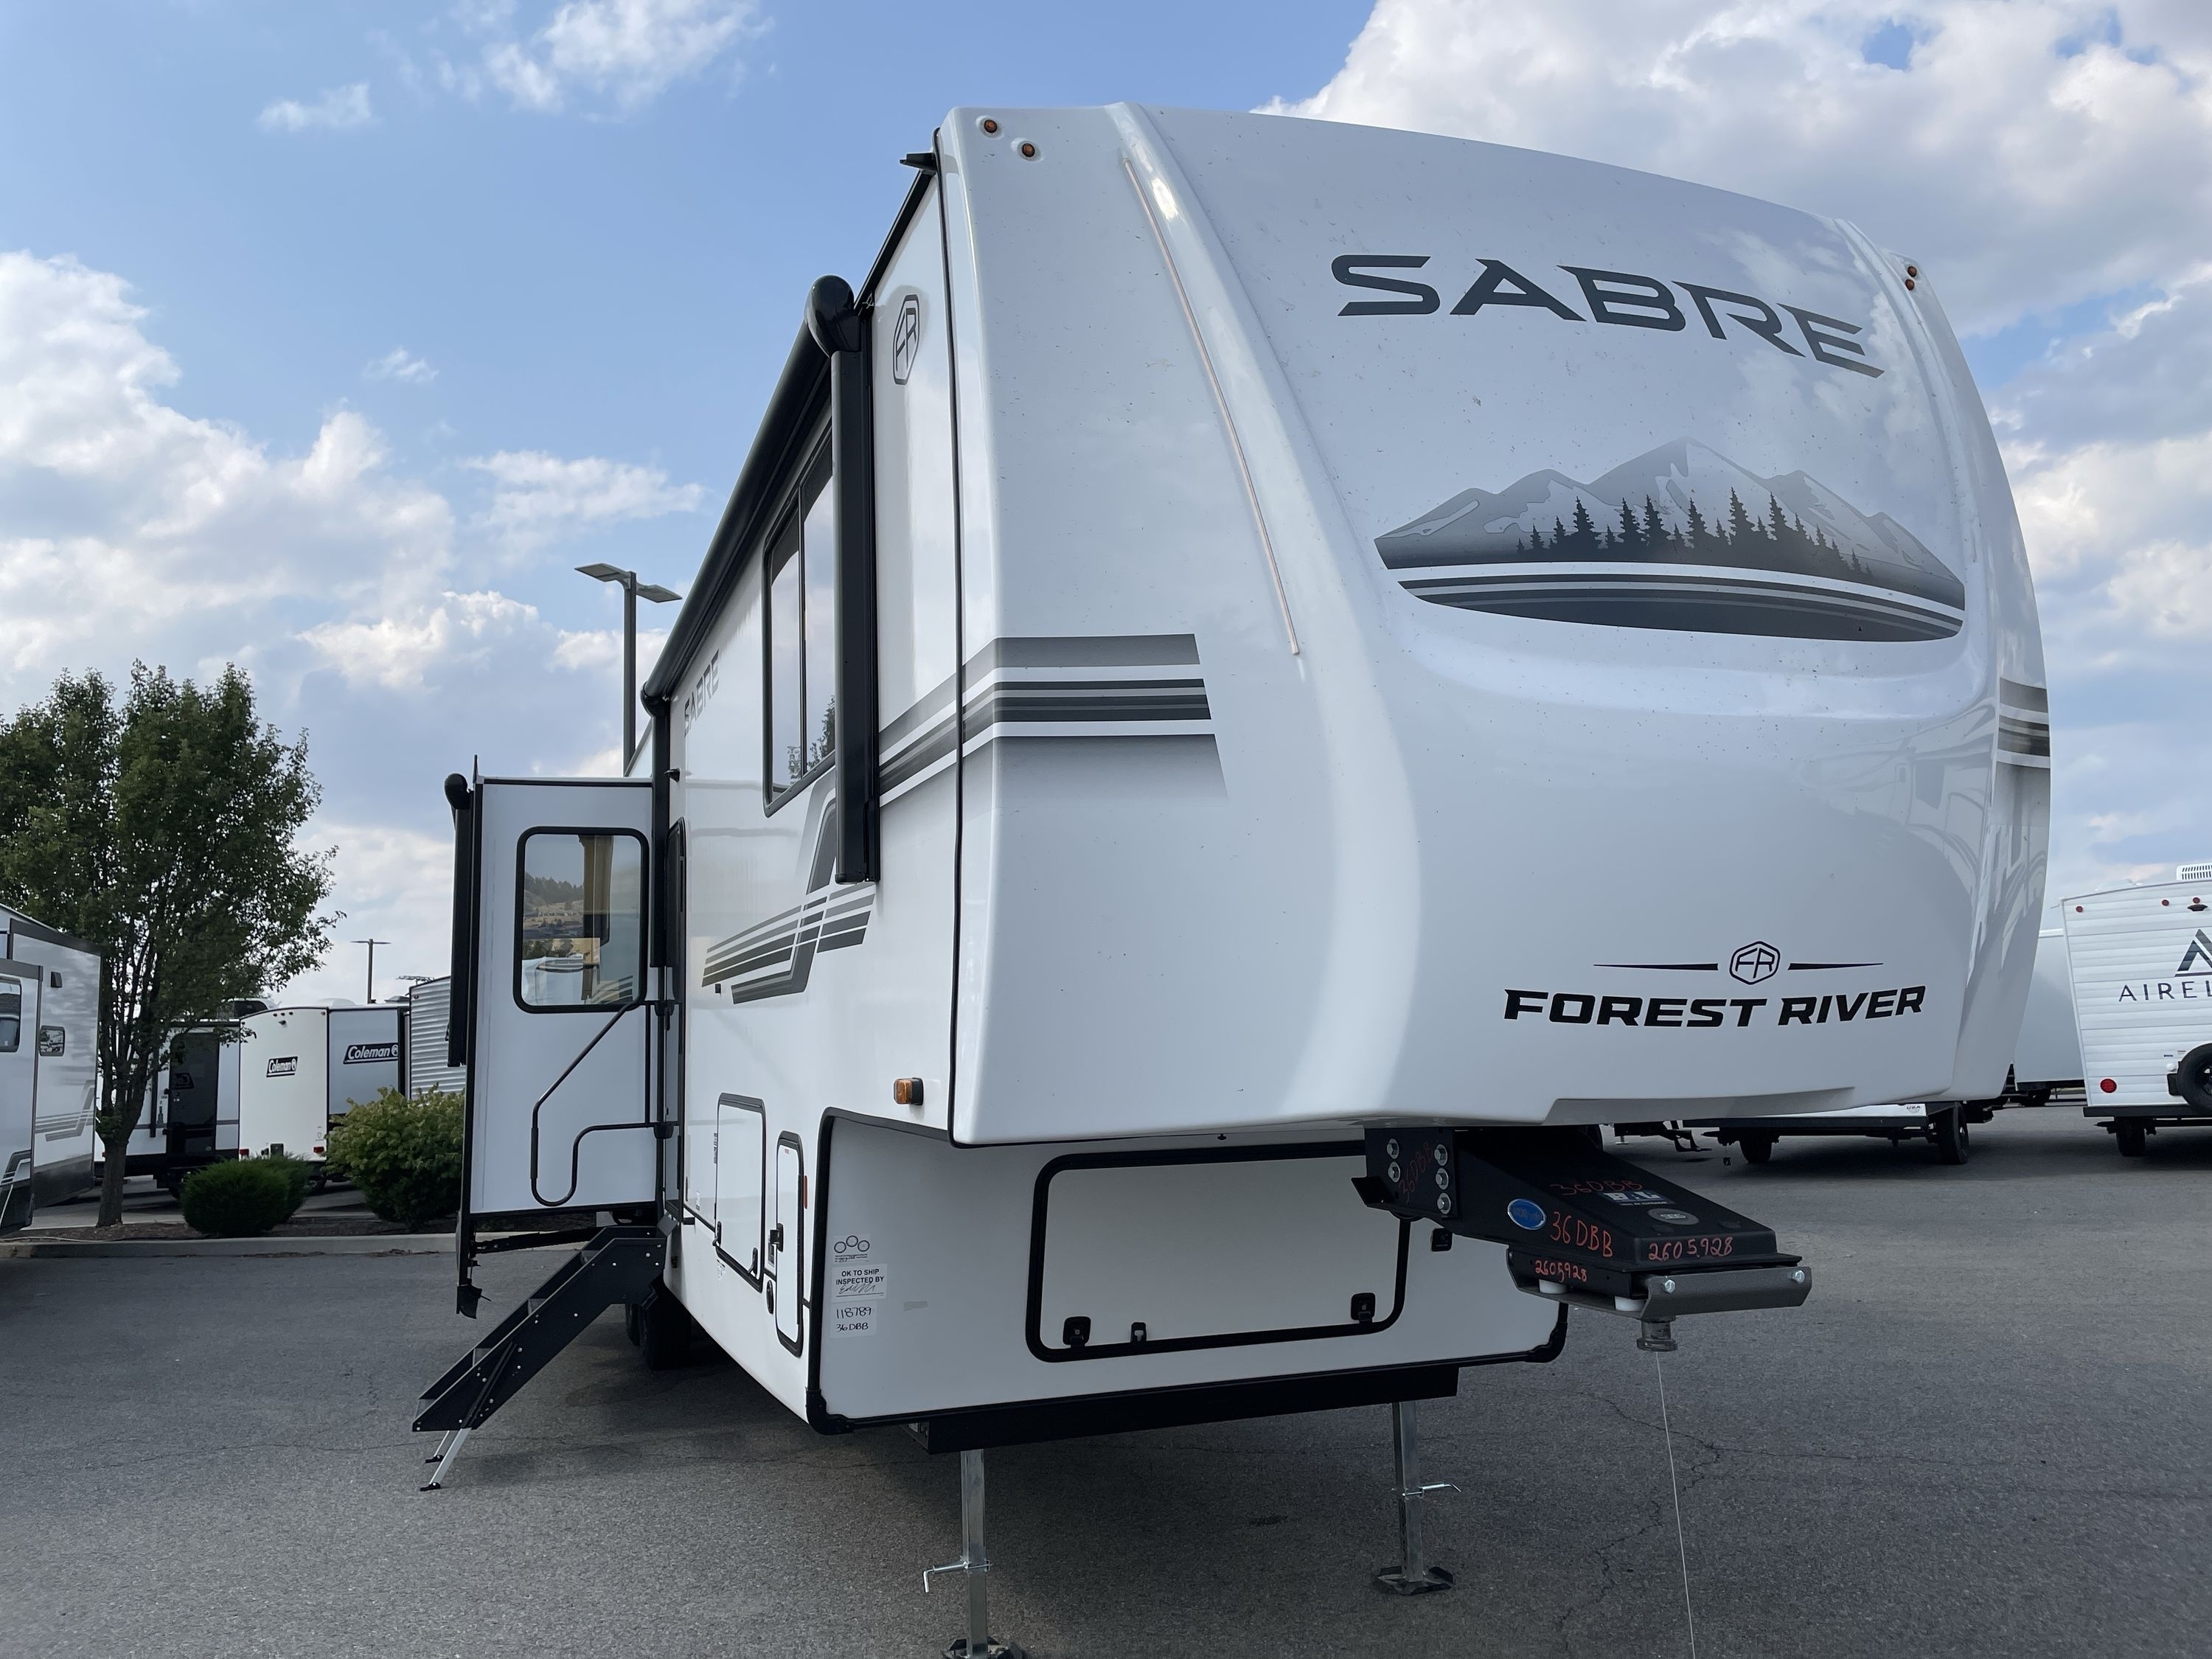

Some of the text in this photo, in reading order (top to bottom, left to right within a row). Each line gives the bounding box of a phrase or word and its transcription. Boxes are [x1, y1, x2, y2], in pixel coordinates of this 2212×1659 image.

[1330, 254, 1885, 379] SABRE
[684, 648, 720, 738] SABRE
[1503, 984, 1927, 1028] FOREST RIVER
[347, 1045, 391, 1060] Coleman
[268, 1058, 292, 1074] Coleman
[1549, 1180, 1644, 1196] 36DBB
[1549, 1211, 1613, 1258] 36DBB
[1647, 1236, 1733, 1262] 2605928
[841, 1270, 852, 1278] OK
[1534, 1259, 1588, 1283] 2605928
[835, 1276, 874, 1285] INSPECTED
[836, 1306, 872, 1319] 118789
[835, 1322, 869, 1333] 36DBB
